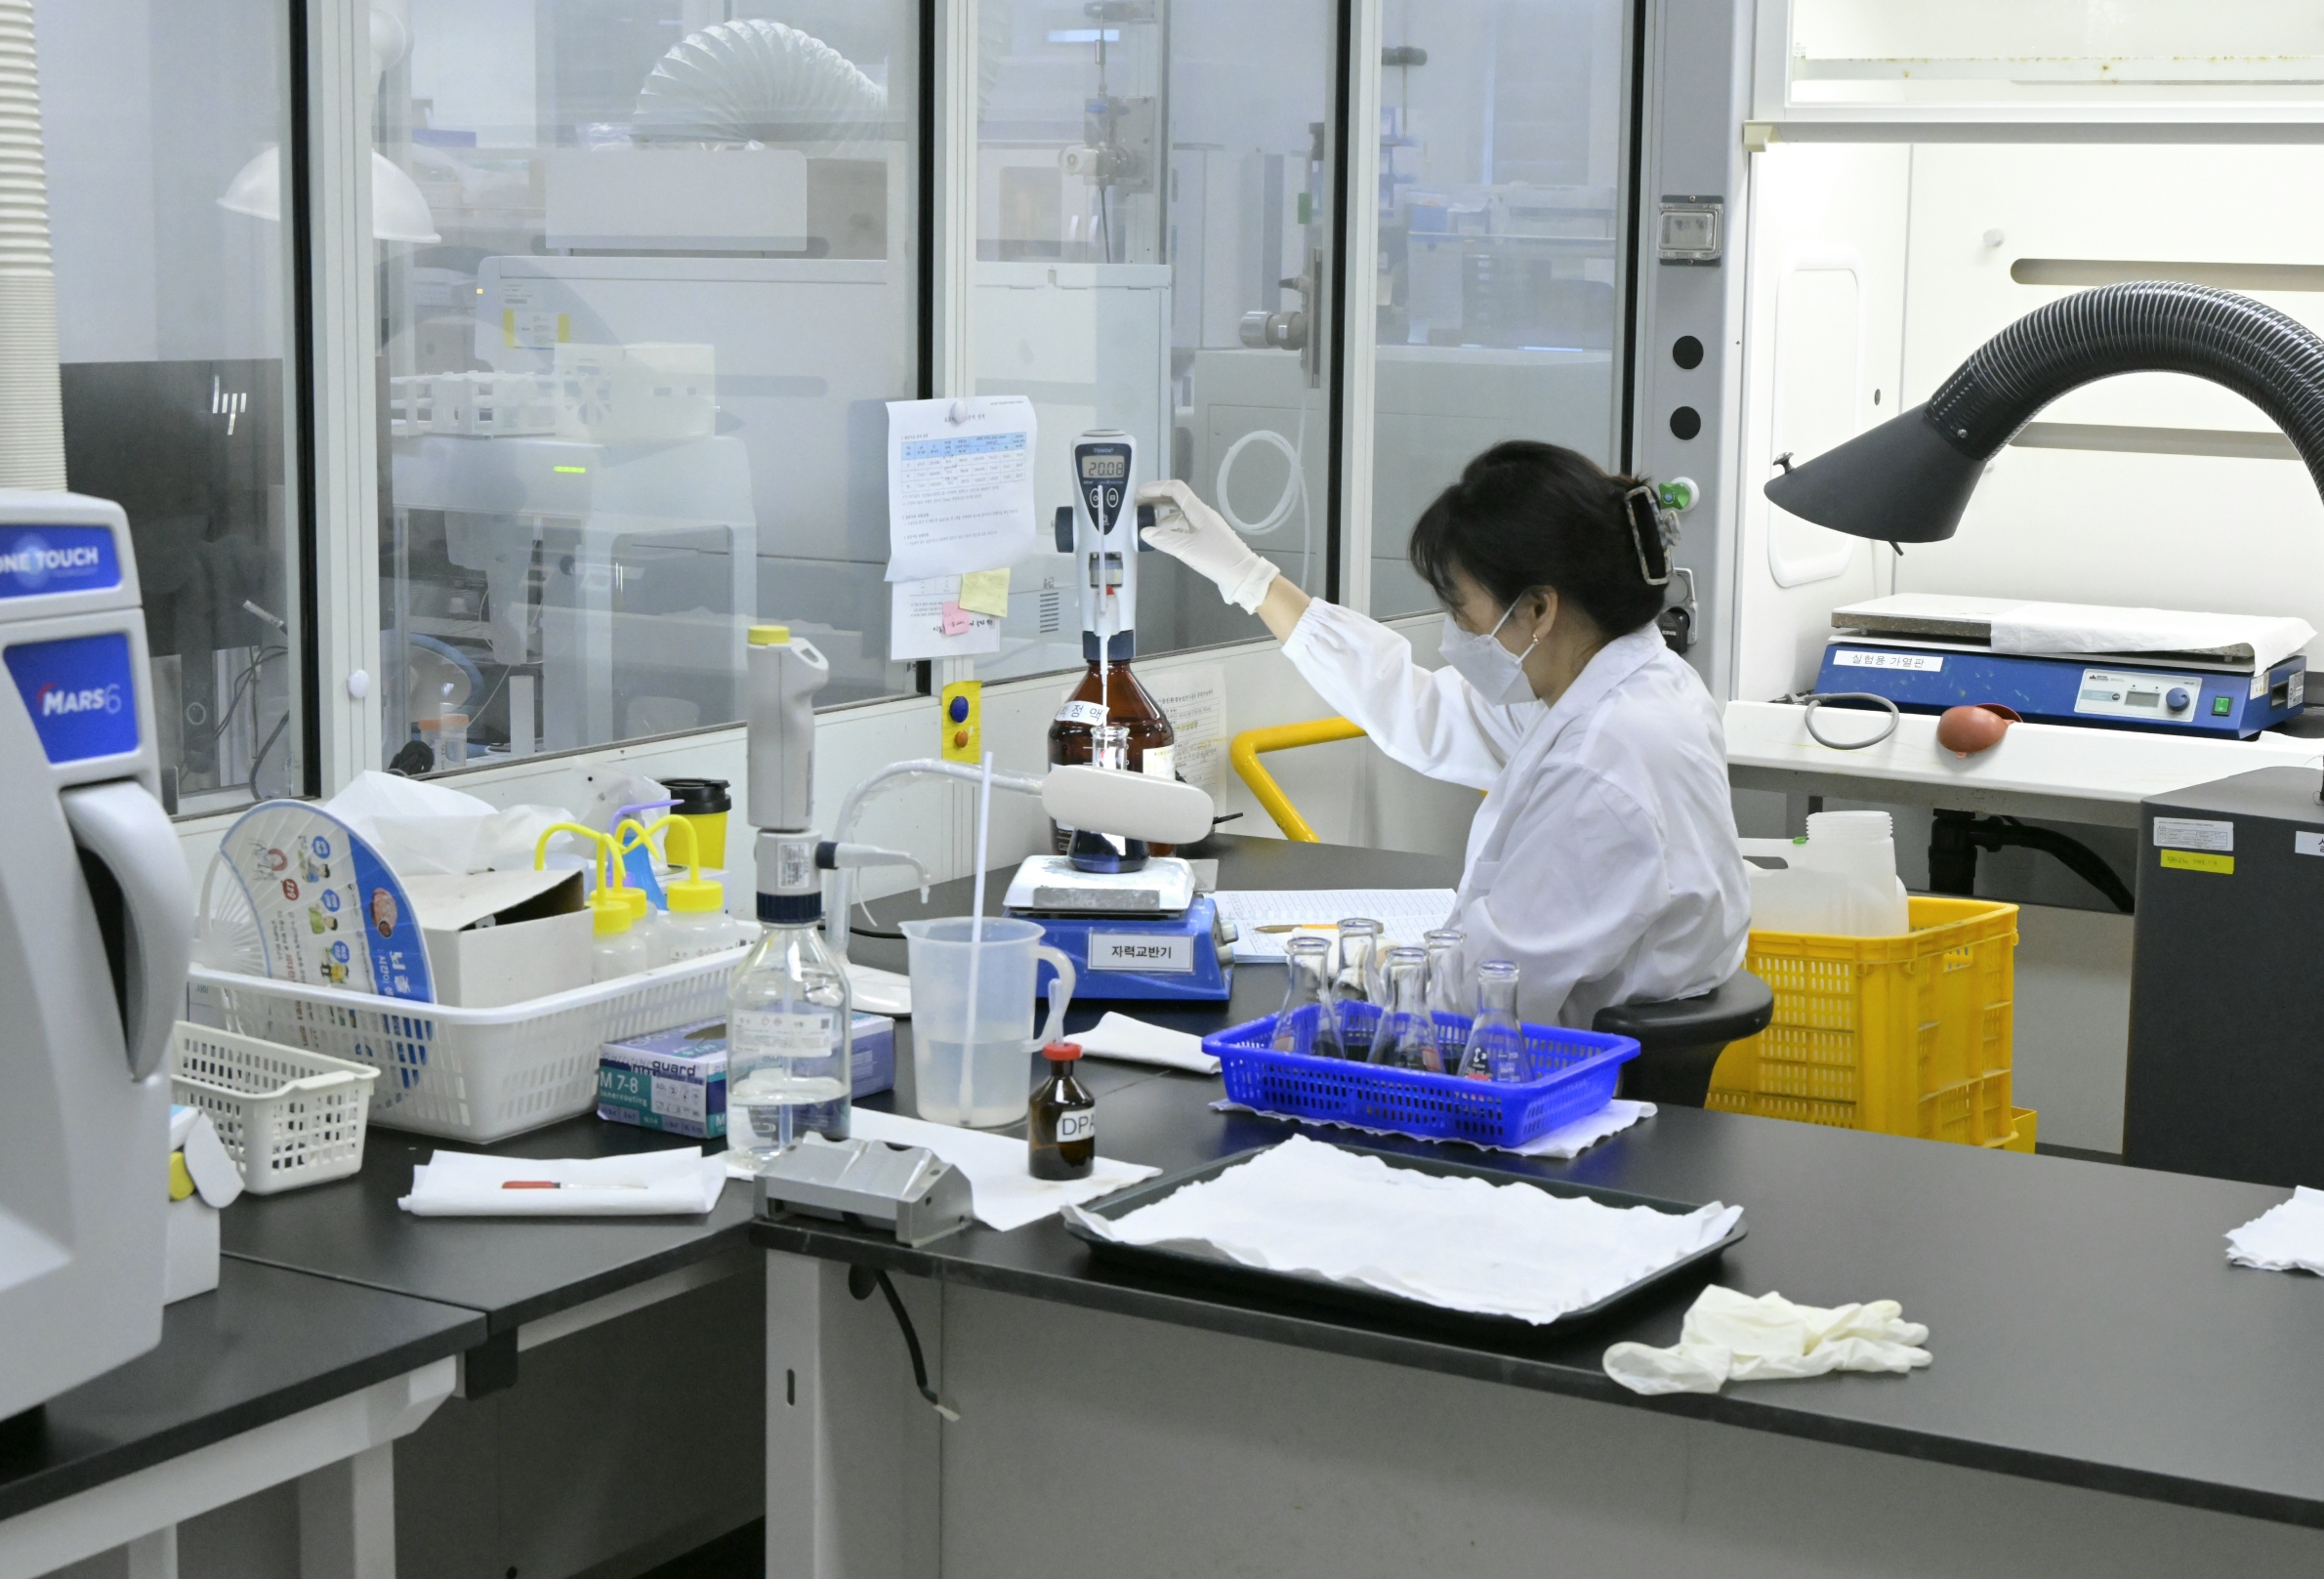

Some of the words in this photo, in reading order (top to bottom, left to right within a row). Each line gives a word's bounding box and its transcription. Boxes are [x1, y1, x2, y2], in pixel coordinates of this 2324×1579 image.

[212, 374, 246, 436] hp
[1088, 461, 1124, 476] 20.08
[36, 547, 99, 569] TOUCH
[1851, 653, 1886, 666] 실험용
[1889, 656, 1925, 669] 가열판
[1111, 945, 1172, 959] 자력교반기
[599, 1070, 612, 1089] M
[617, 1075, 639, 1094] 7-8
